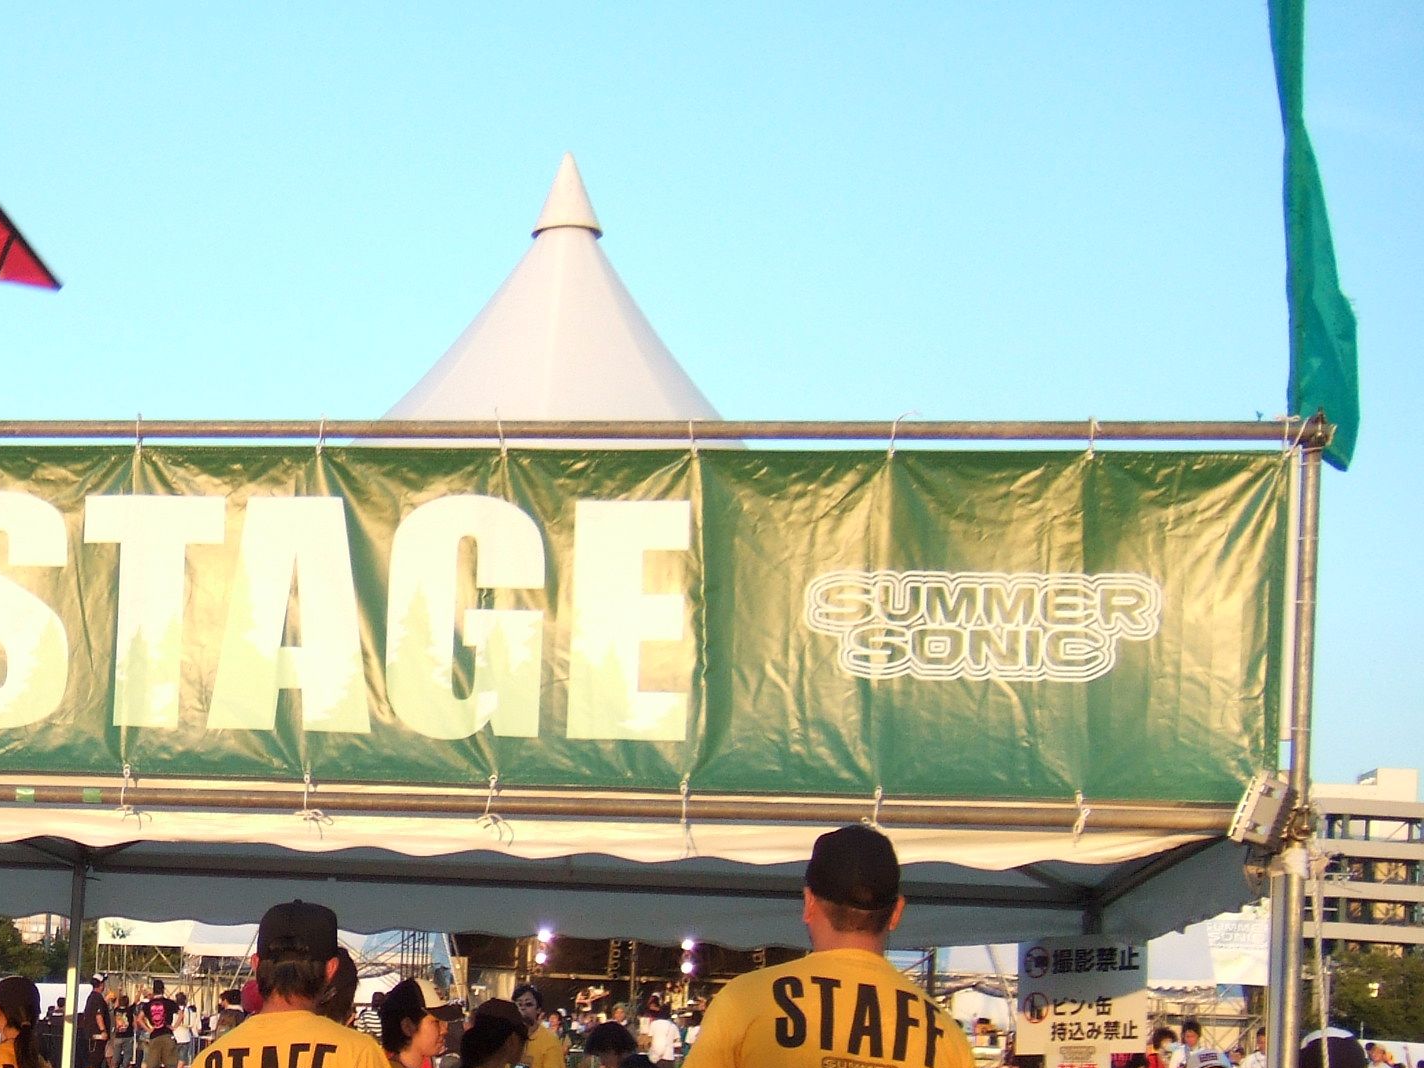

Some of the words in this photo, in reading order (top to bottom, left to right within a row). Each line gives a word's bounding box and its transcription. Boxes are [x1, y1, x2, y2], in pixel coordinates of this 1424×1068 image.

[809, 576, 1157, 628] SUMMER
[845, 624, 1112, 676] SONIC
[1052, 945, 1140, 975] 撮影禁止
[772, 975, 945, 1068] STAFF
[1051, 1020, 1139, 1042] 持込み禁止
